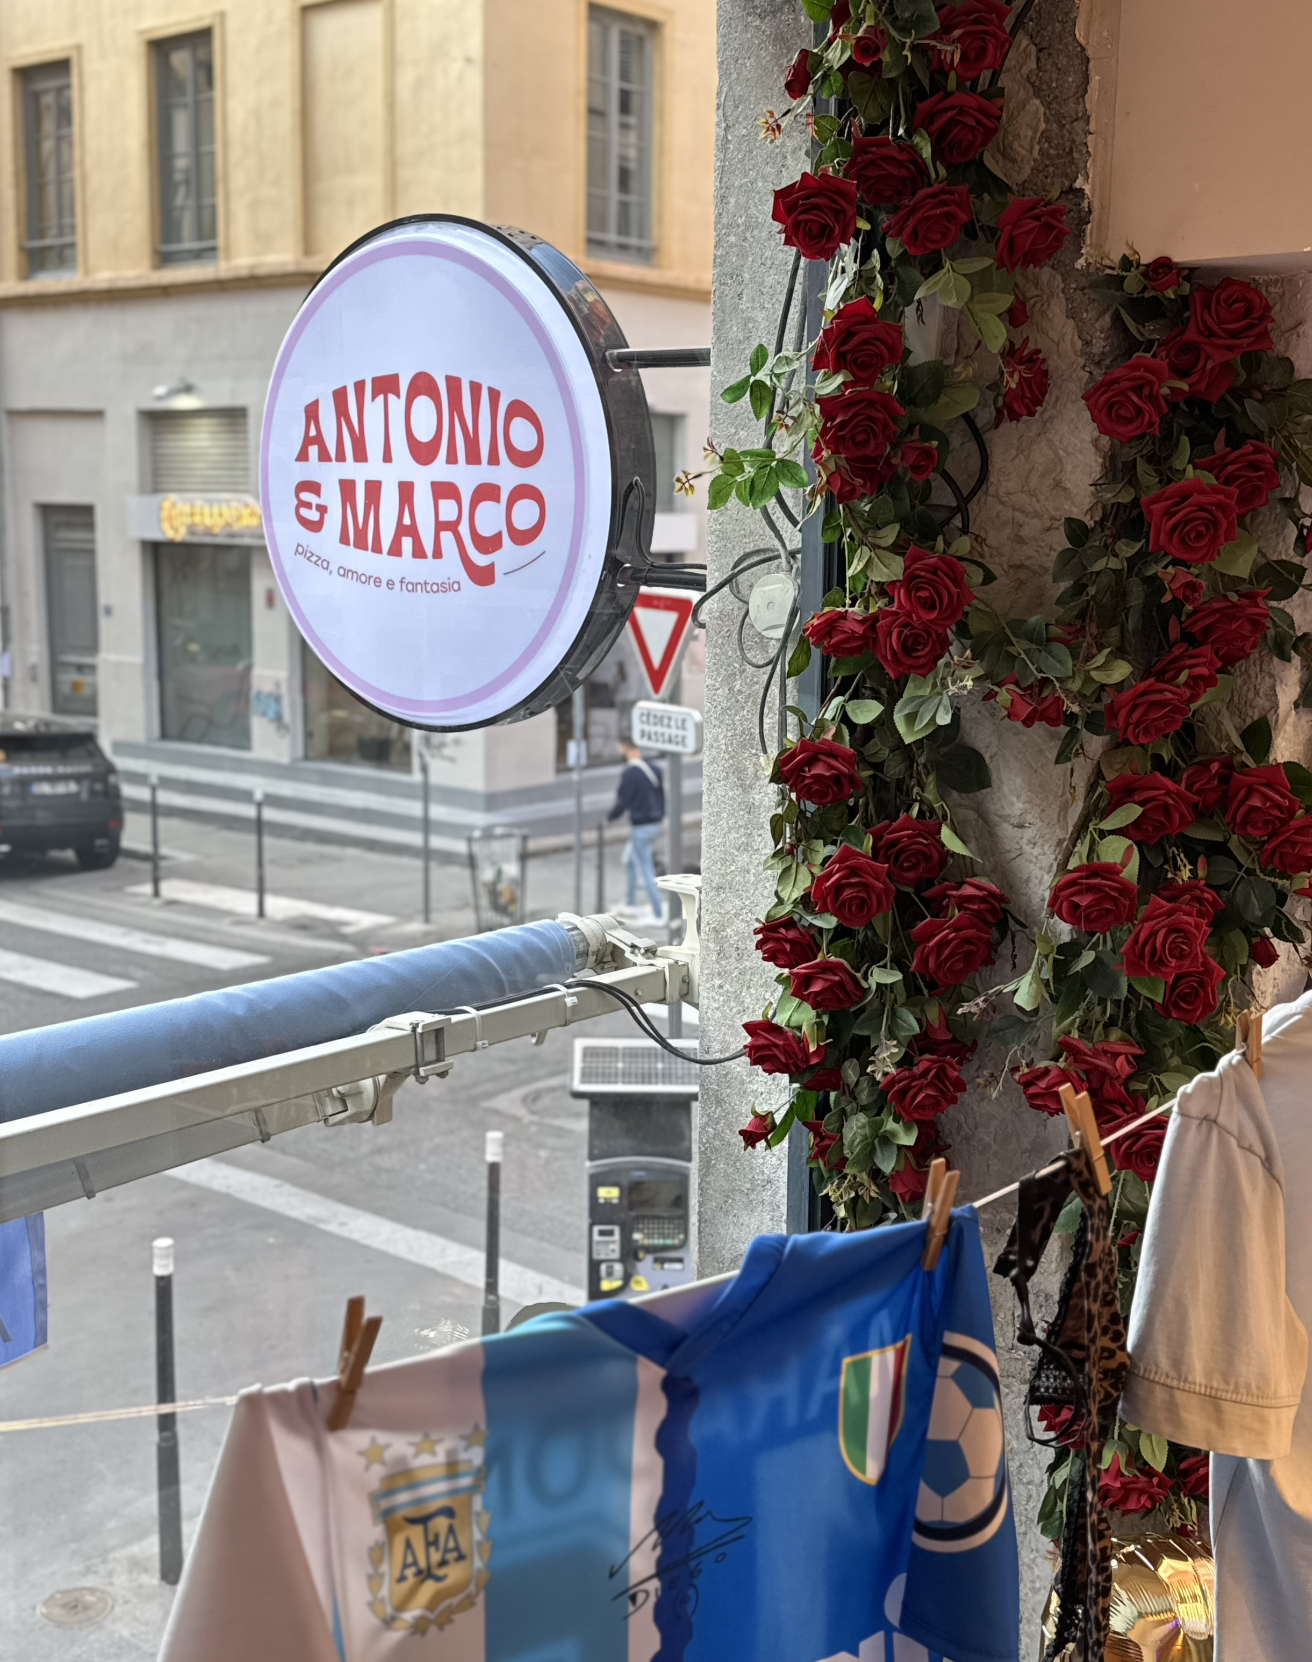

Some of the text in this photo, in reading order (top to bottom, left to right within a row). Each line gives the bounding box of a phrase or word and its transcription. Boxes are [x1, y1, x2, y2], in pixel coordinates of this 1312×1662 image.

[294, 371, 545, 468] ANTONIO
[294, 480, 328, 533] &
[338, 478, 546, 587] MARCO
[294, 542, 462, 594] pizza, amore e fantasia
[640, 729, 687, 747] PASSAGE
[675, 717, 687, 730] LE
[396, 1506, 466, 1584] AFA
